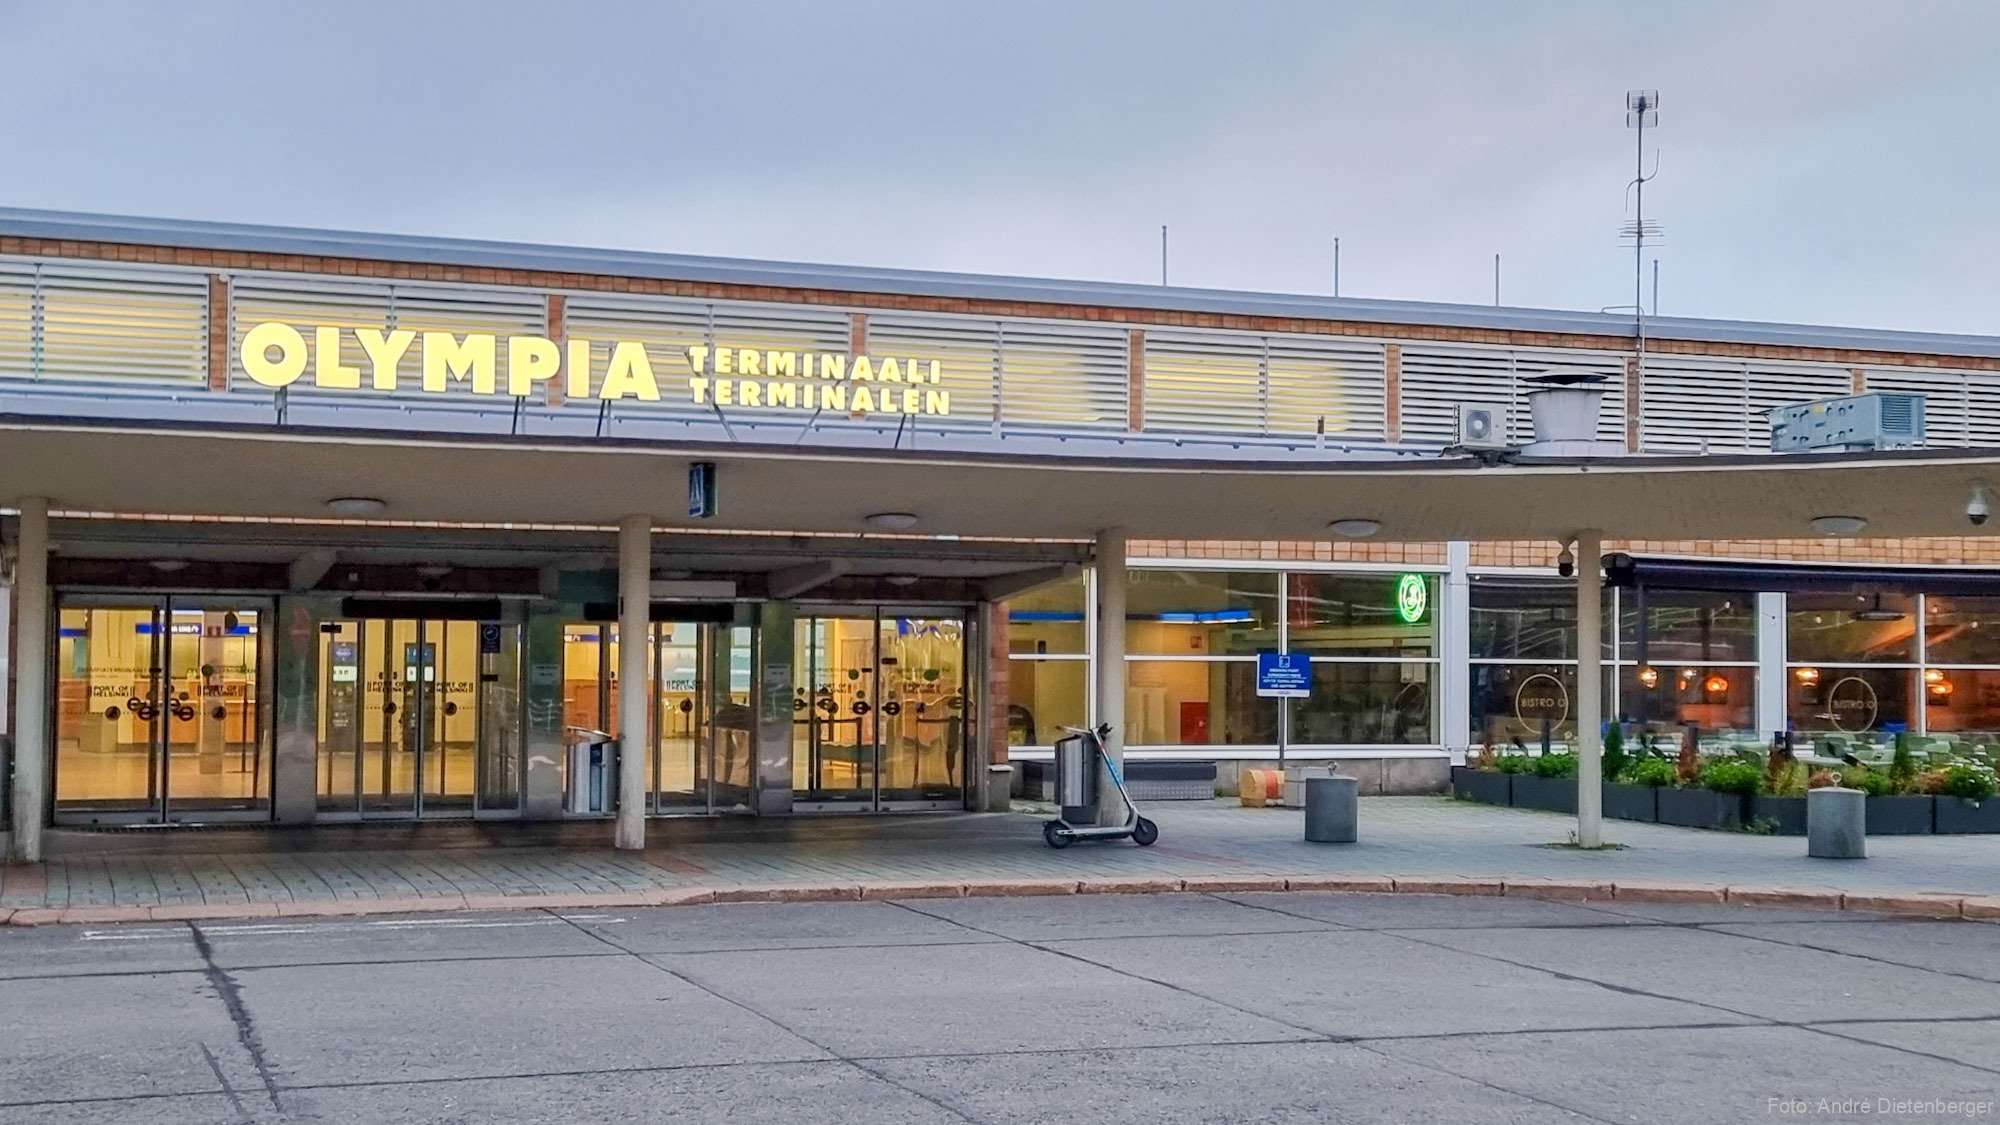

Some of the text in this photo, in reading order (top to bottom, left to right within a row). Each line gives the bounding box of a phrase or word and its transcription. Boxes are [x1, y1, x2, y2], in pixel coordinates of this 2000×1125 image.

[240, 321, 661, 401] OLYMPIA
[688, 345, 941, 385] TERMINAALI
[688, 377, 950, 415] TERMINALEN
[1521, 698, 1566, 708] BISTRO O
